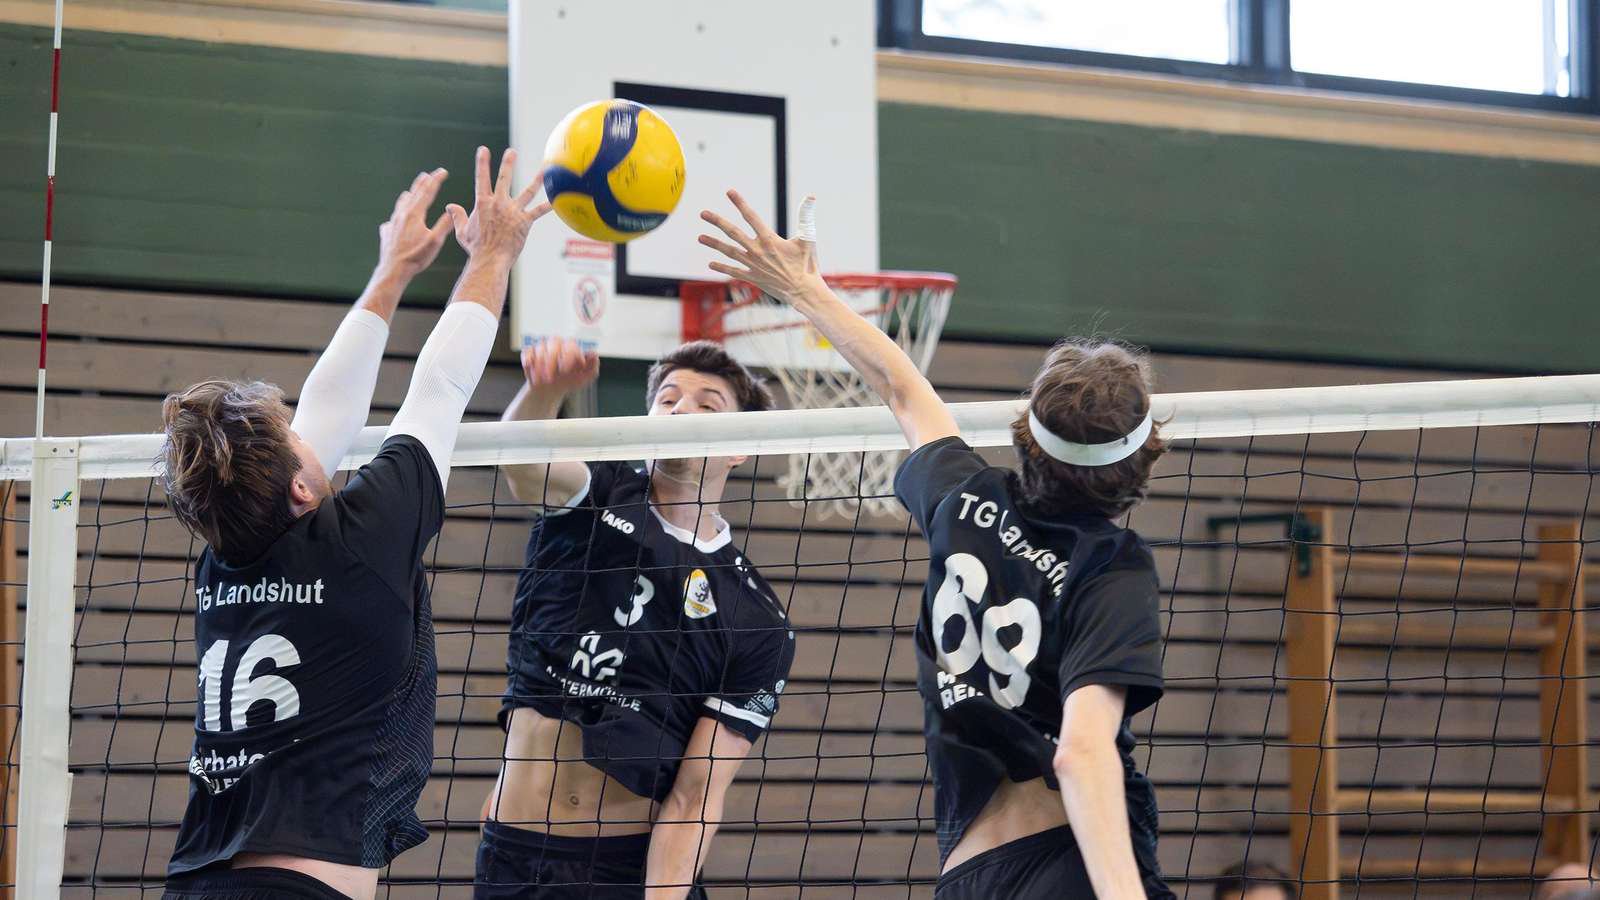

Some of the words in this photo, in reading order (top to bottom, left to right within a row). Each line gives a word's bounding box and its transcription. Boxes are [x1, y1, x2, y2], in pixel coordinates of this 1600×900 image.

[958, 492, 998, 528] TG
[195, 585, 212, 613] TG
[215, 577, 324, 606] Landshut
[613, 574, 655, 627] 3
[932, 553, 1041, 710] 69
[198, 633, 302, 732] 16
